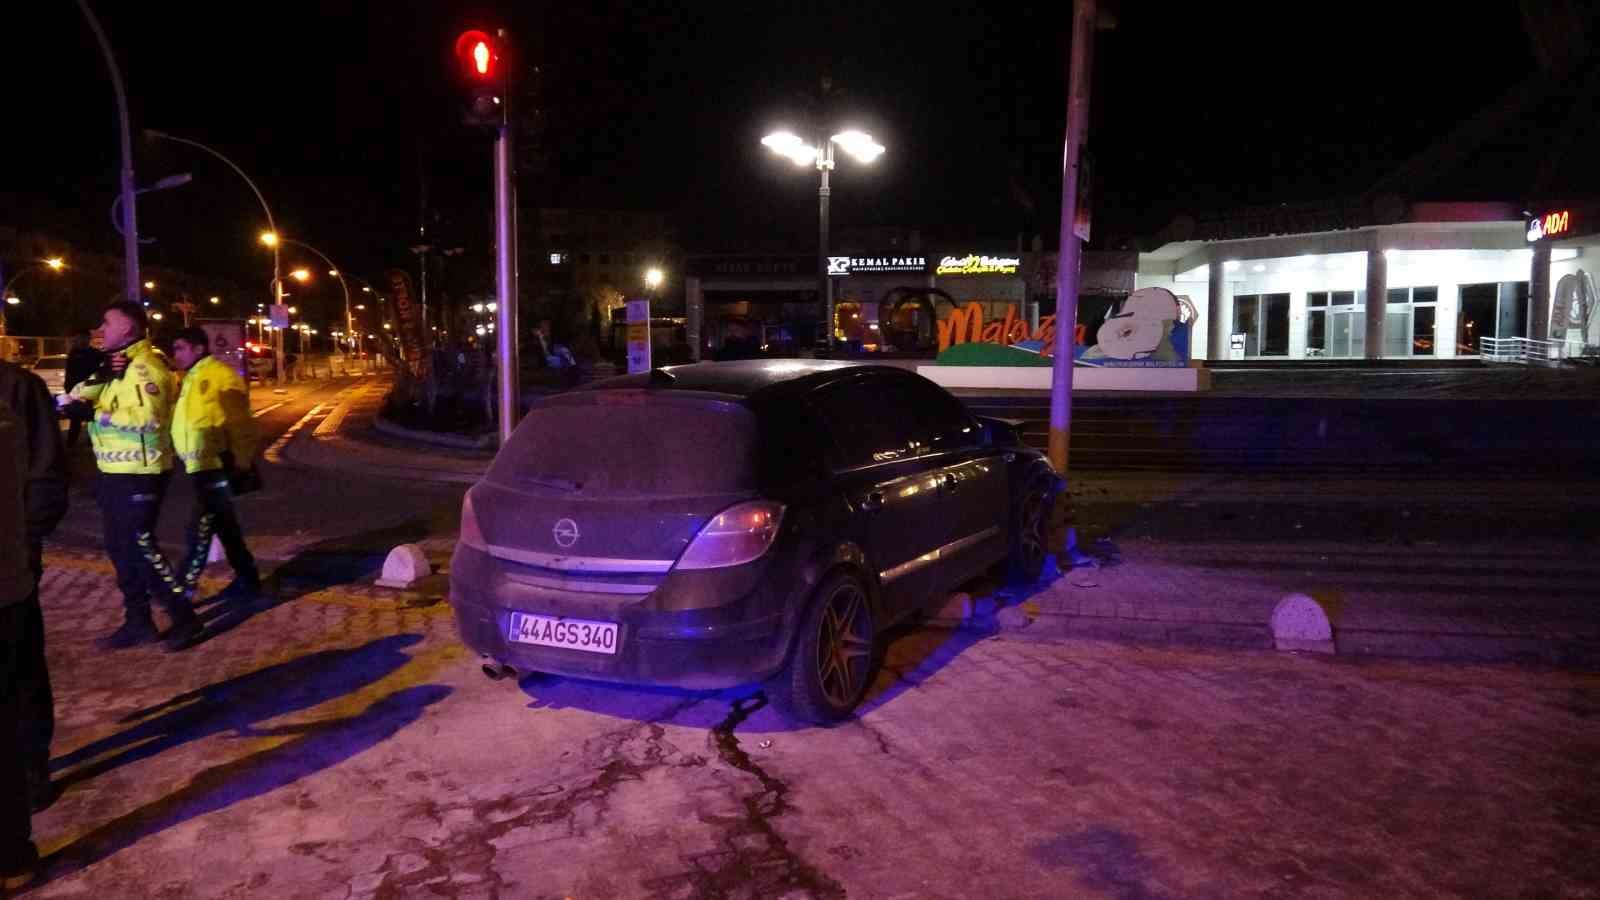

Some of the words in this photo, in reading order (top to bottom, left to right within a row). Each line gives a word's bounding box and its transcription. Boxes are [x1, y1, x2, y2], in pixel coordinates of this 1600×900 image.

[1543, 211, 1568, 235] ADA
[851, 258, 889, 266] KEMAL
[520, 617, 614, 649] 44AGS340
